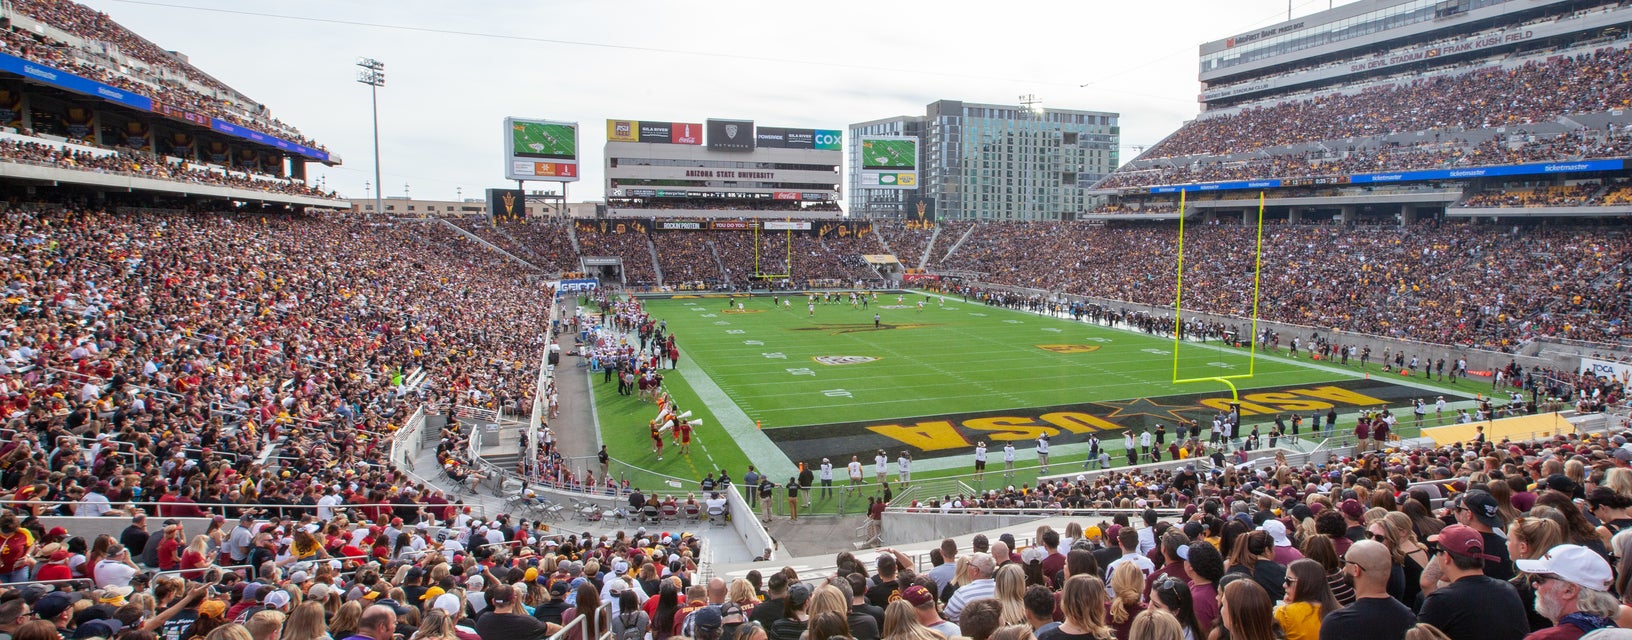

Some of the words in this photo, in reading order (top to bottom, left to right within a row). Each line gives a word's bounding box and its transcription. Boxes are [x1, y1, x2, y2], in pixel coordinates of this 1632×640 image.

[1293, 22, 1305, 30] BOX
[1351, 64, 1366, 72] SUN
[1368, 60, 1387, 69] DEVIL
[1389, 52, 1422, 65] STADIUM
[1443, 42, 1473, 54] FRANK
[1475, 37, 1501, 48] KUSH
[1505, 31, 1533, 42] FIELD
[815, 134, 842, 145] COX
[1545, 163, 1589, 172] ticketmaster
[686, 170, 714, 178] ARIZONA
[738, 171, 775, 179] UNIVERSITY
[1450, 169, 1486, 177] ticketmaster
[561, 282, 597, 291] GEICO
[1592, 363, 1614, 374] TOCA
